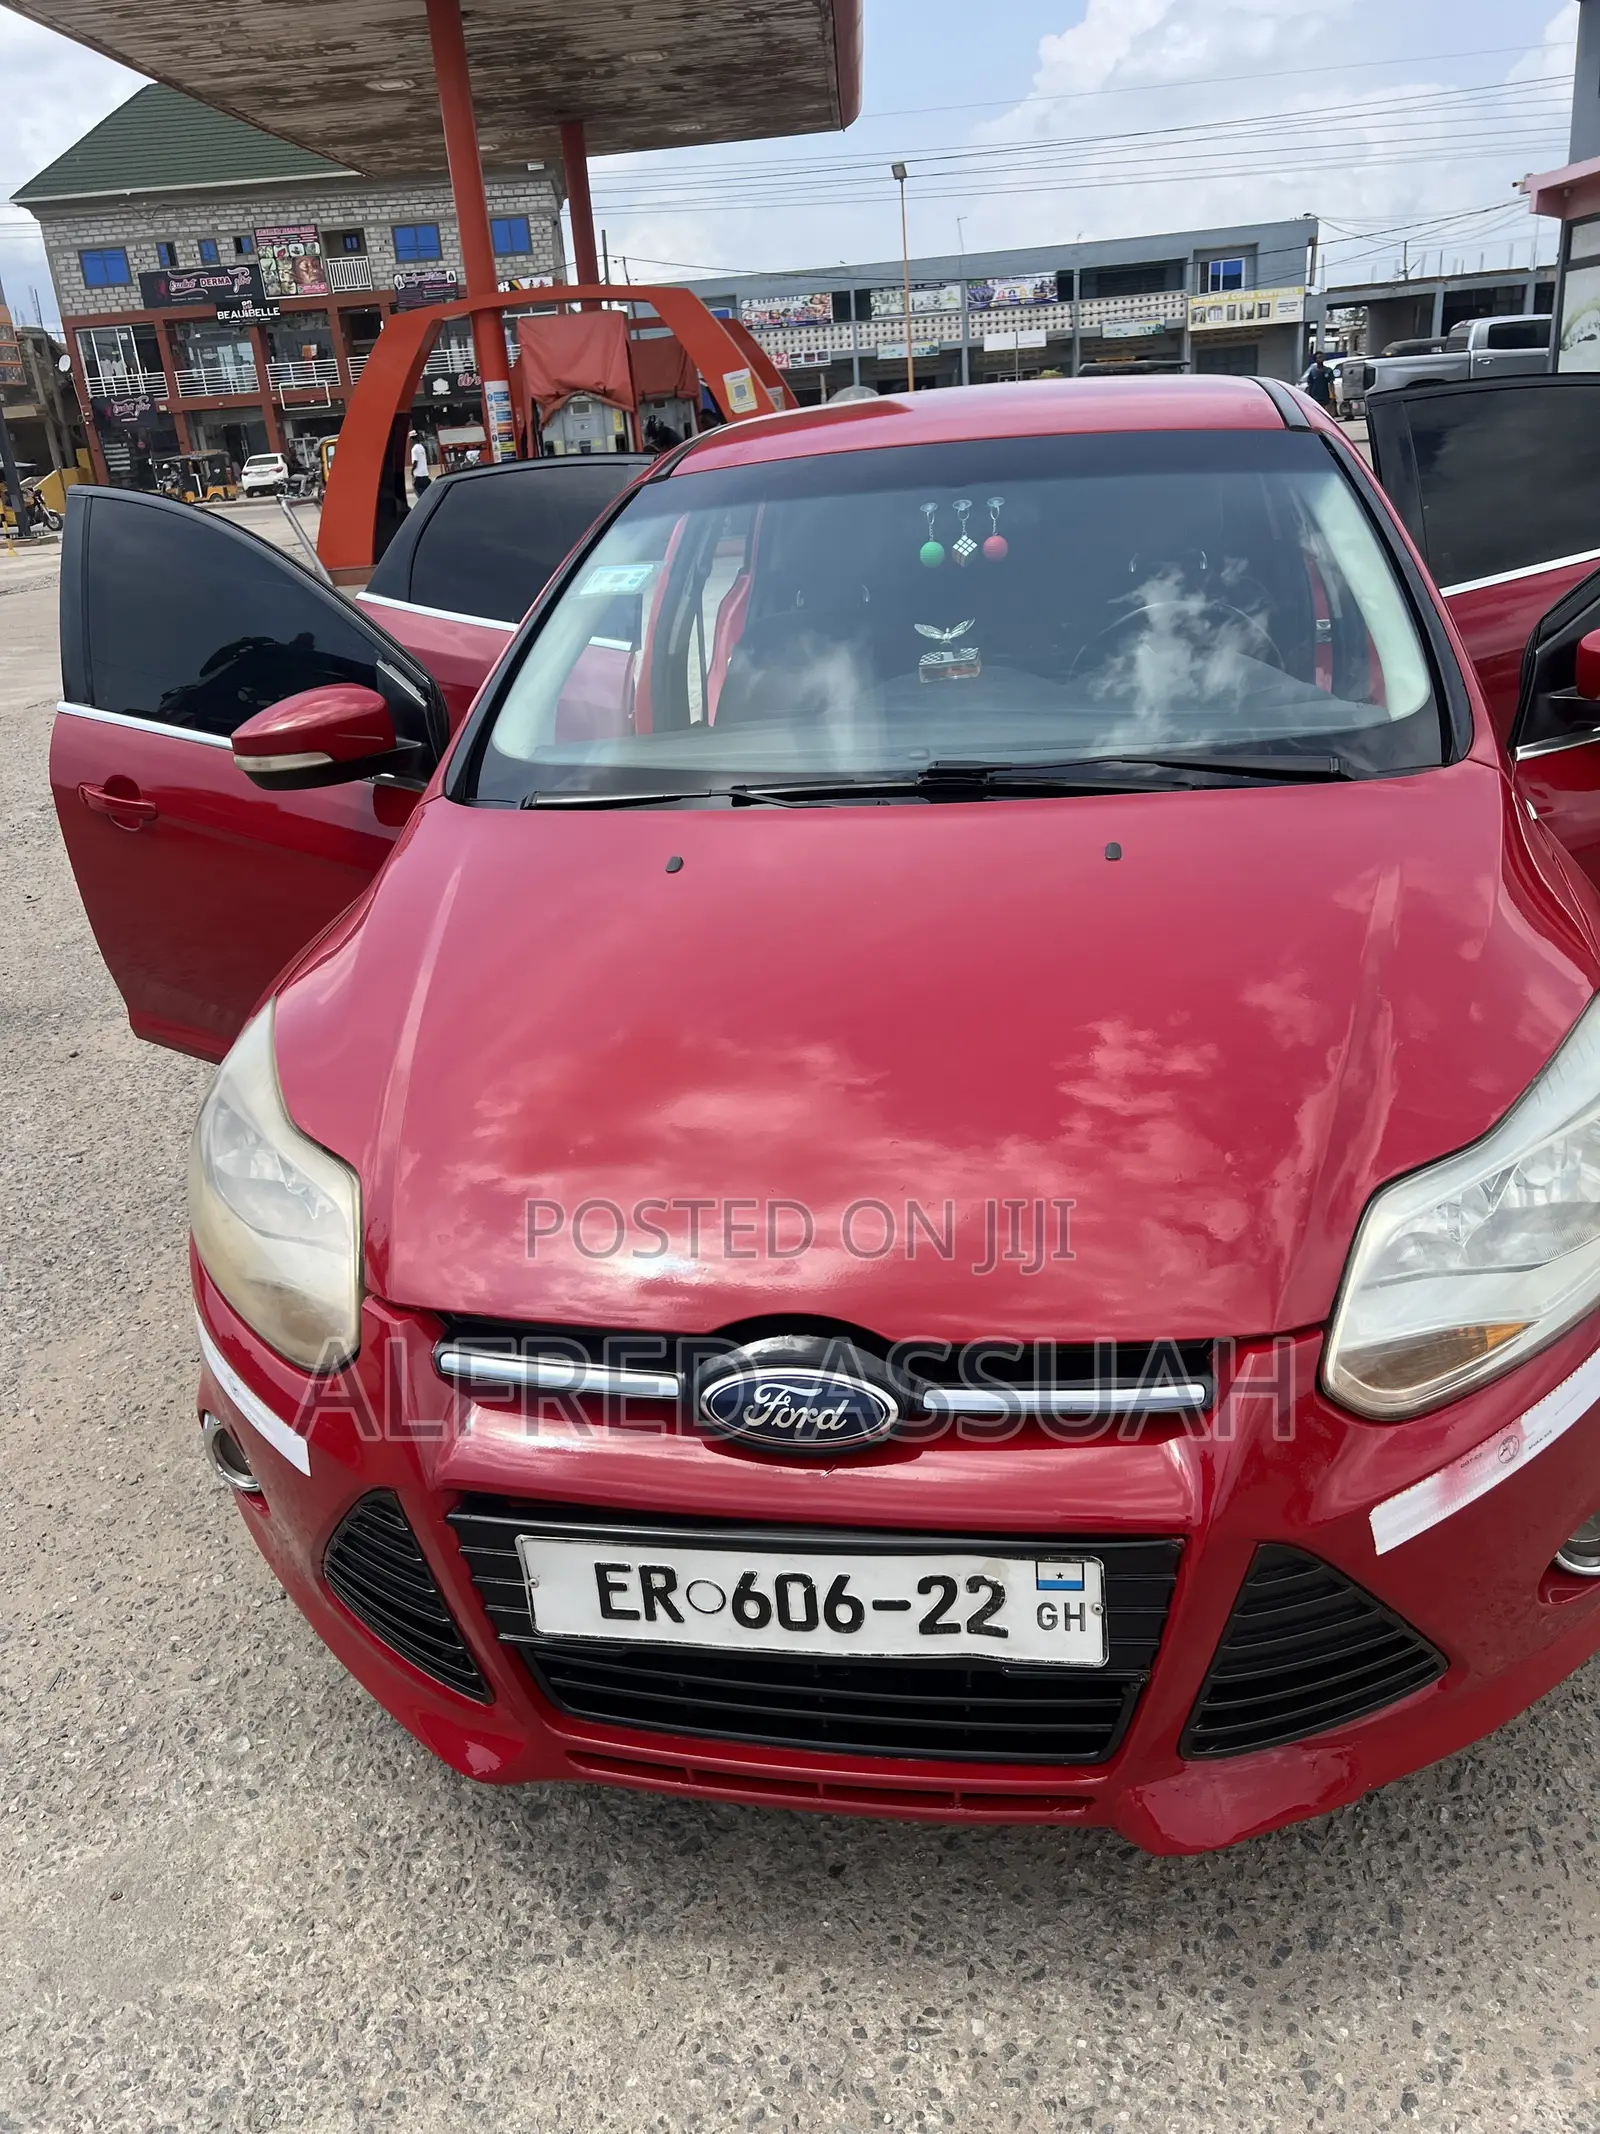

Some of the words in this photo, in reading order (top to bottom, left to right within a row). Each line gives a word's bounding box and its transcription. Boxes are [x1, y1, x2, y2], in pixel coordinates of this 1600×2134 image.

[199, 276, 232, 288] DERMA
[742, 1382, 851, 1432] Ford
[593, 1560, 687, 1625] ER
[730, 1569, 1010, 1640] 606-22
[1036, 1601, 1087, 1632] GH
